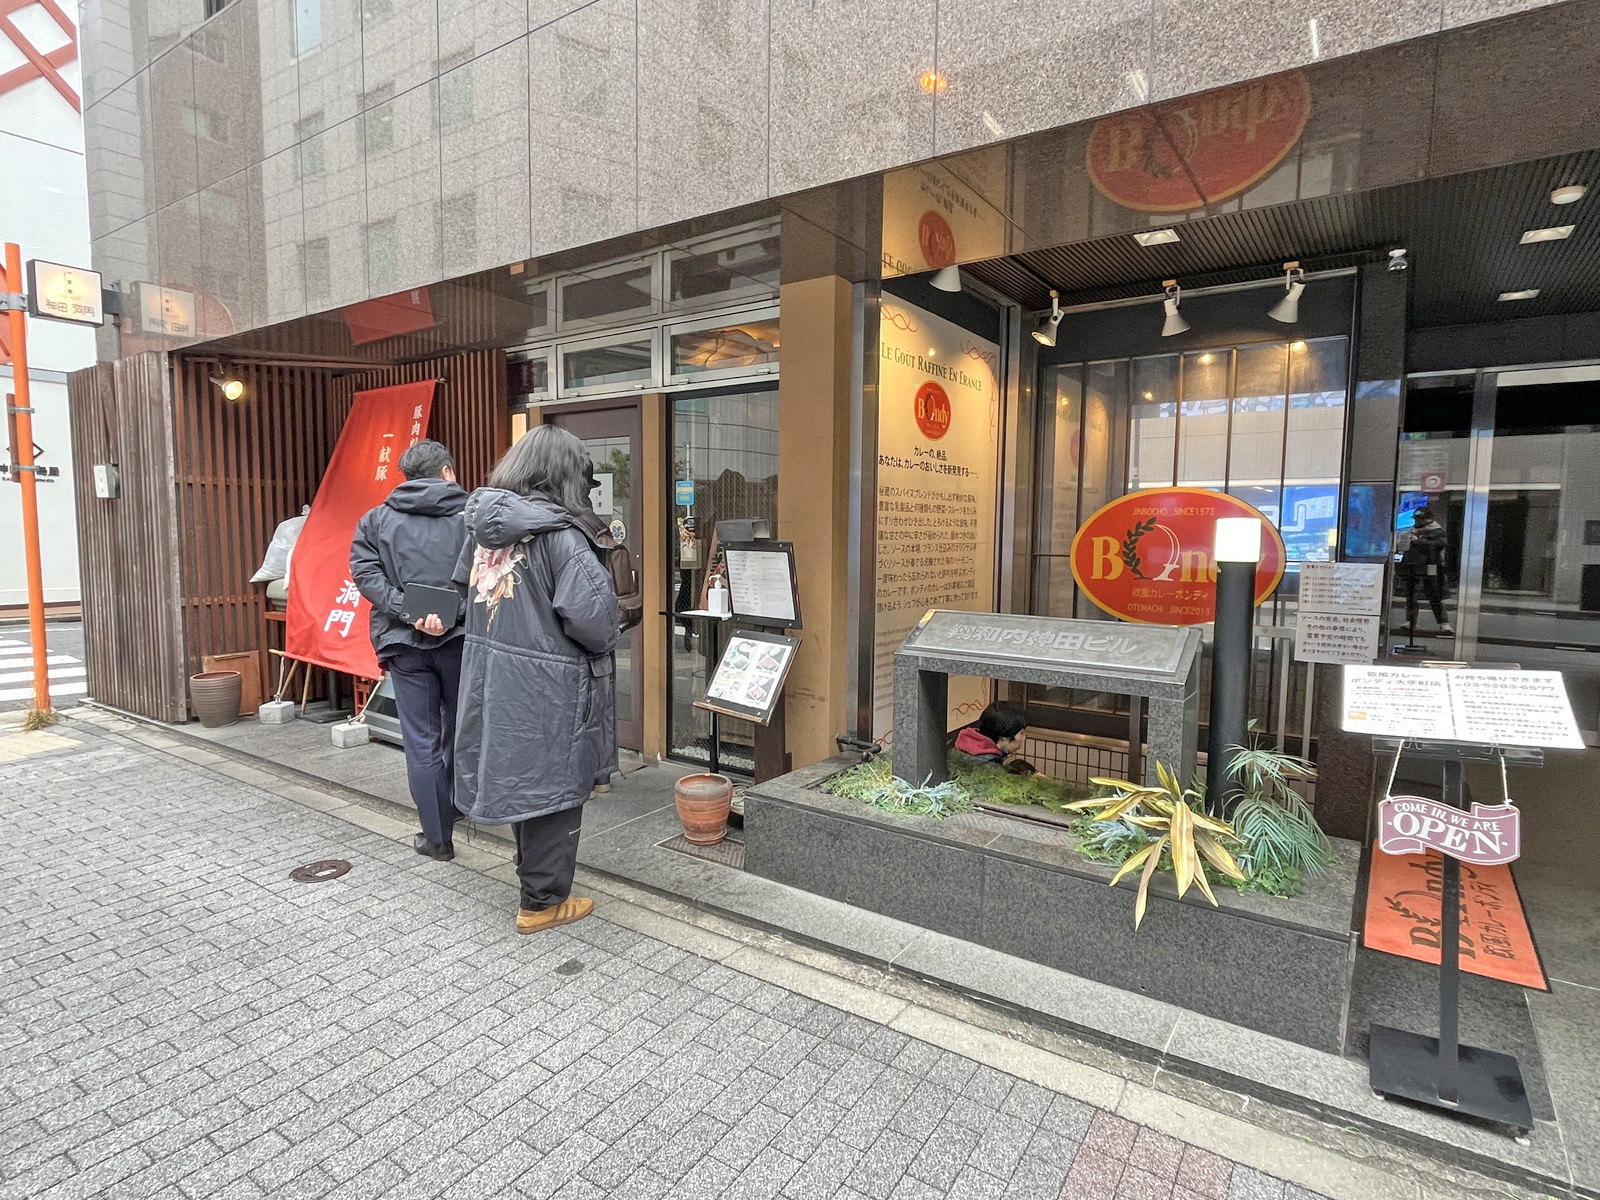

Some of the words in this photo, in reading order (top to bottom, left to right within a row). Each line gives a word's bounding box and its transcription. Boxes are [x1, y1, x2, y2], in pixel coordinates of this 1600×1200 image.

[45, 298, 68, 312] 神田
[881, 342, 892, 361] LE
[949, 366, 958, 383] EN
[375, 433, 395, 482] 一献豚
[1132, 507, 1168, 516] JINBOCHO
[1174, 507, 1215, 516] SINCE1973
[1127, 603, 1164, 613] OTEMACHI
[1169, 605, 1210, 616] SINCE2013
[948, 623, 1139, 655] 翔和内神田ビル
[1394, 803, 1428, 814] COME
[1450, 815, 1469, 828] WE
[1473, 821, 1501, 831] ARE
[1393, 812, 1503, 855] OPEN
